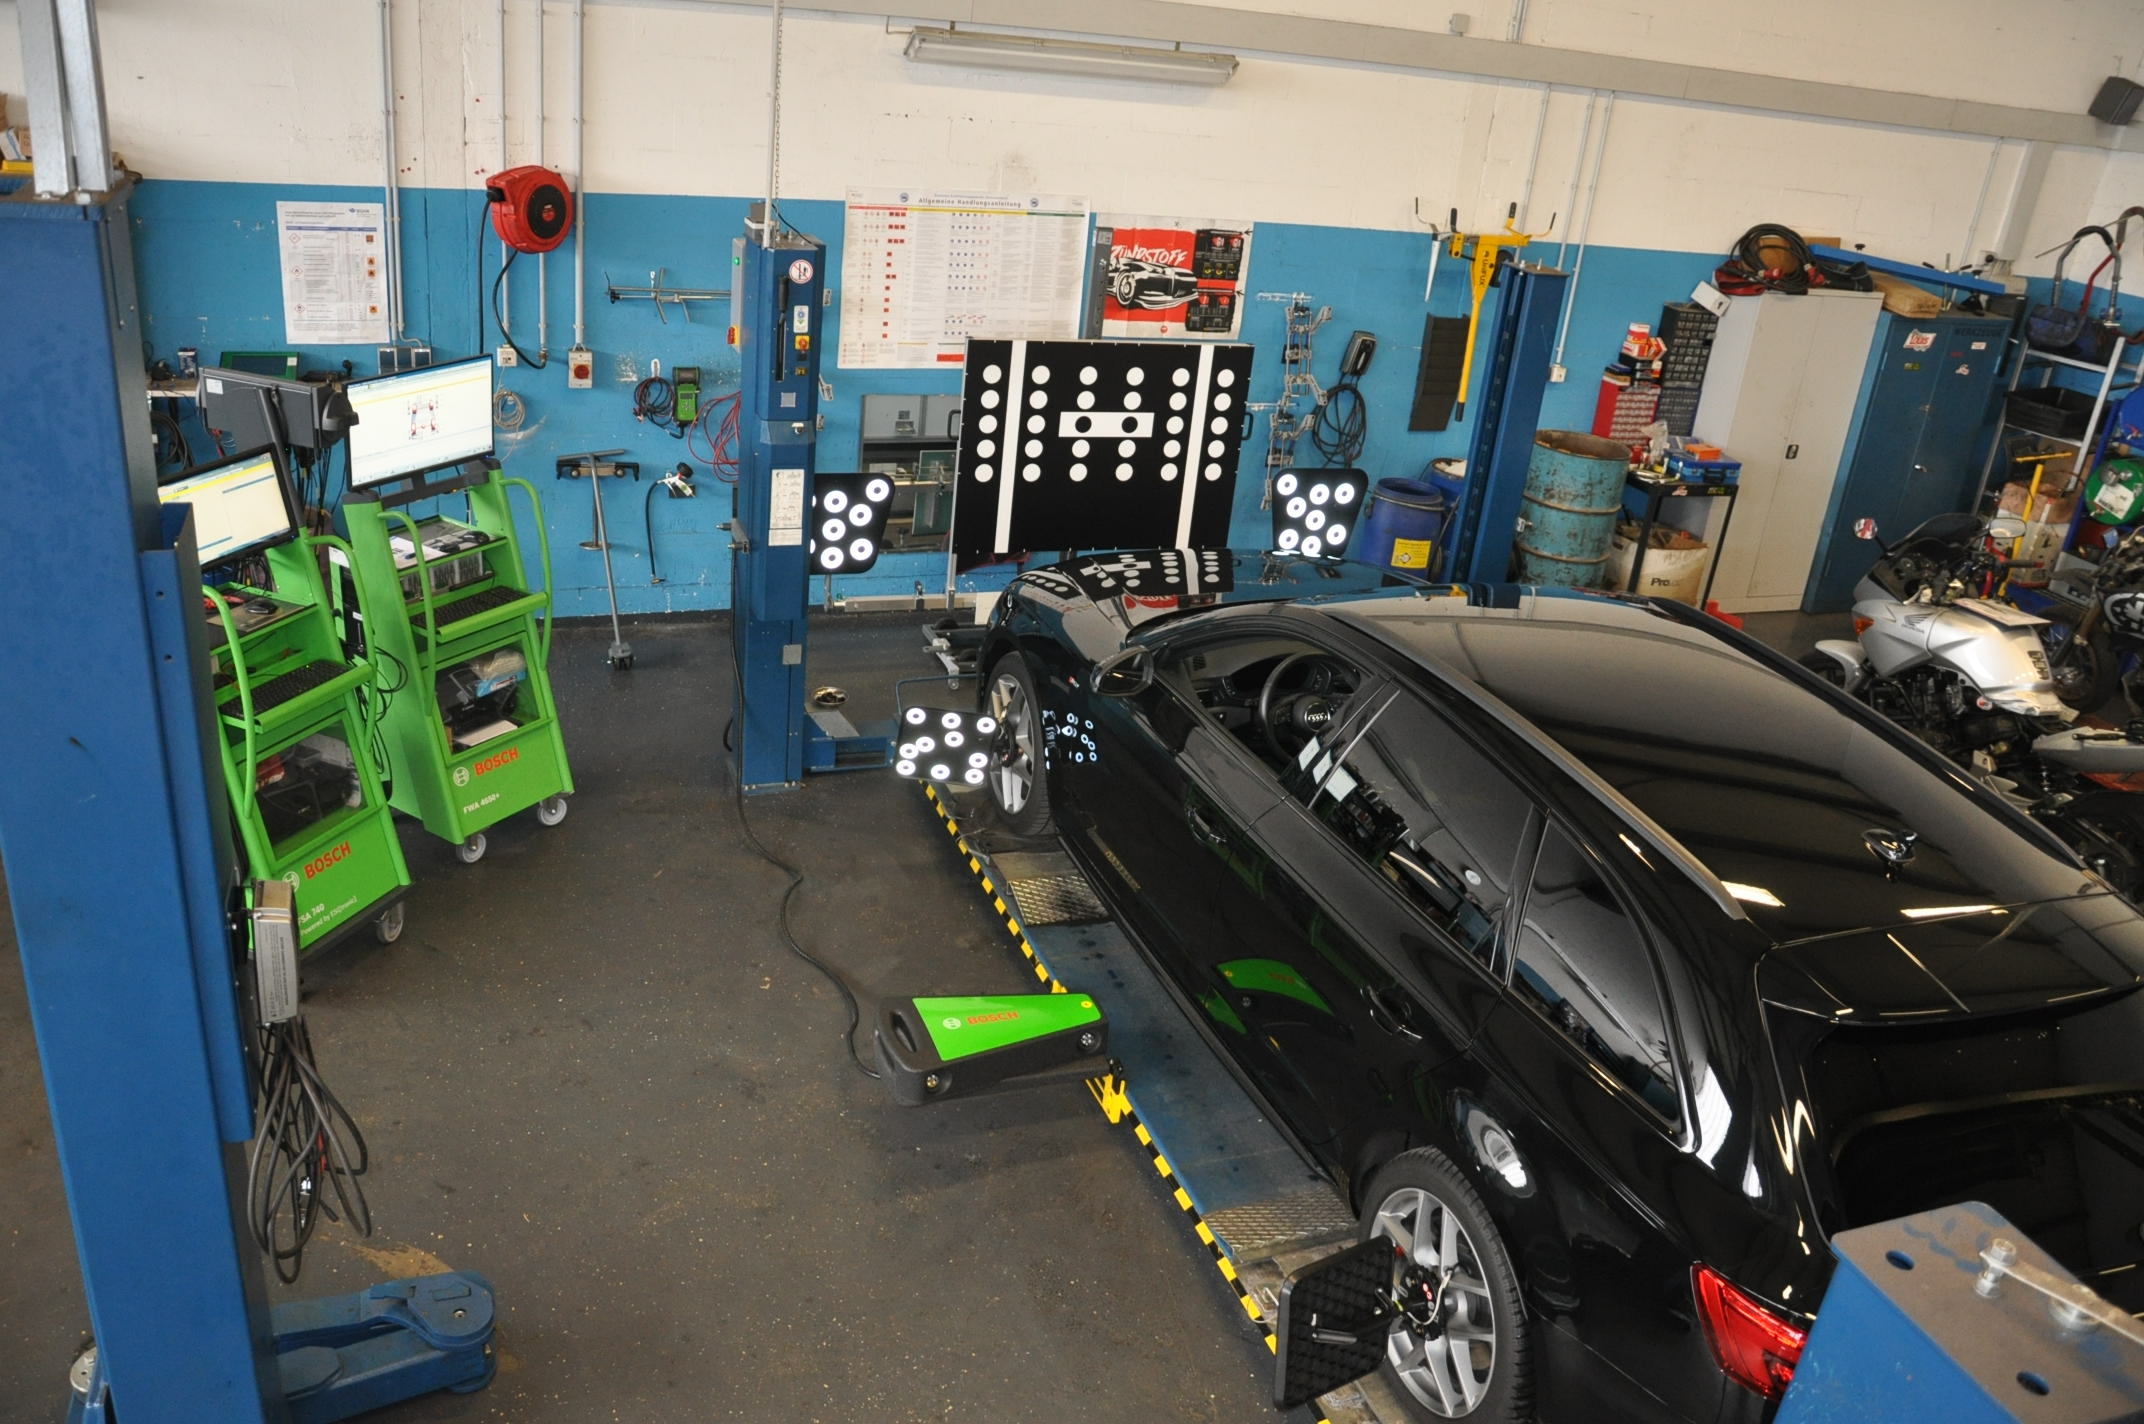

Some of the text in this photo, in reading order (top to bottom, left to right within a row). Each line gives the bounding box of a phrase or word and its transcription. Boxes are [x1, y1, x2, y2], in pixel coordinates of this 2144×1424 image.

[918, 196, 955, 206] Allgemeine
[957, 199, 1022, 208] Handlungsanleitung
[474, 746, 519, 776] BOSCH
[463, 801, 480, 814] FWA
[304, 840, 352, 880] BOSCH
[312, 903, 325, 915] 740
[967, 1011, 1020, 1025] BOSCH
